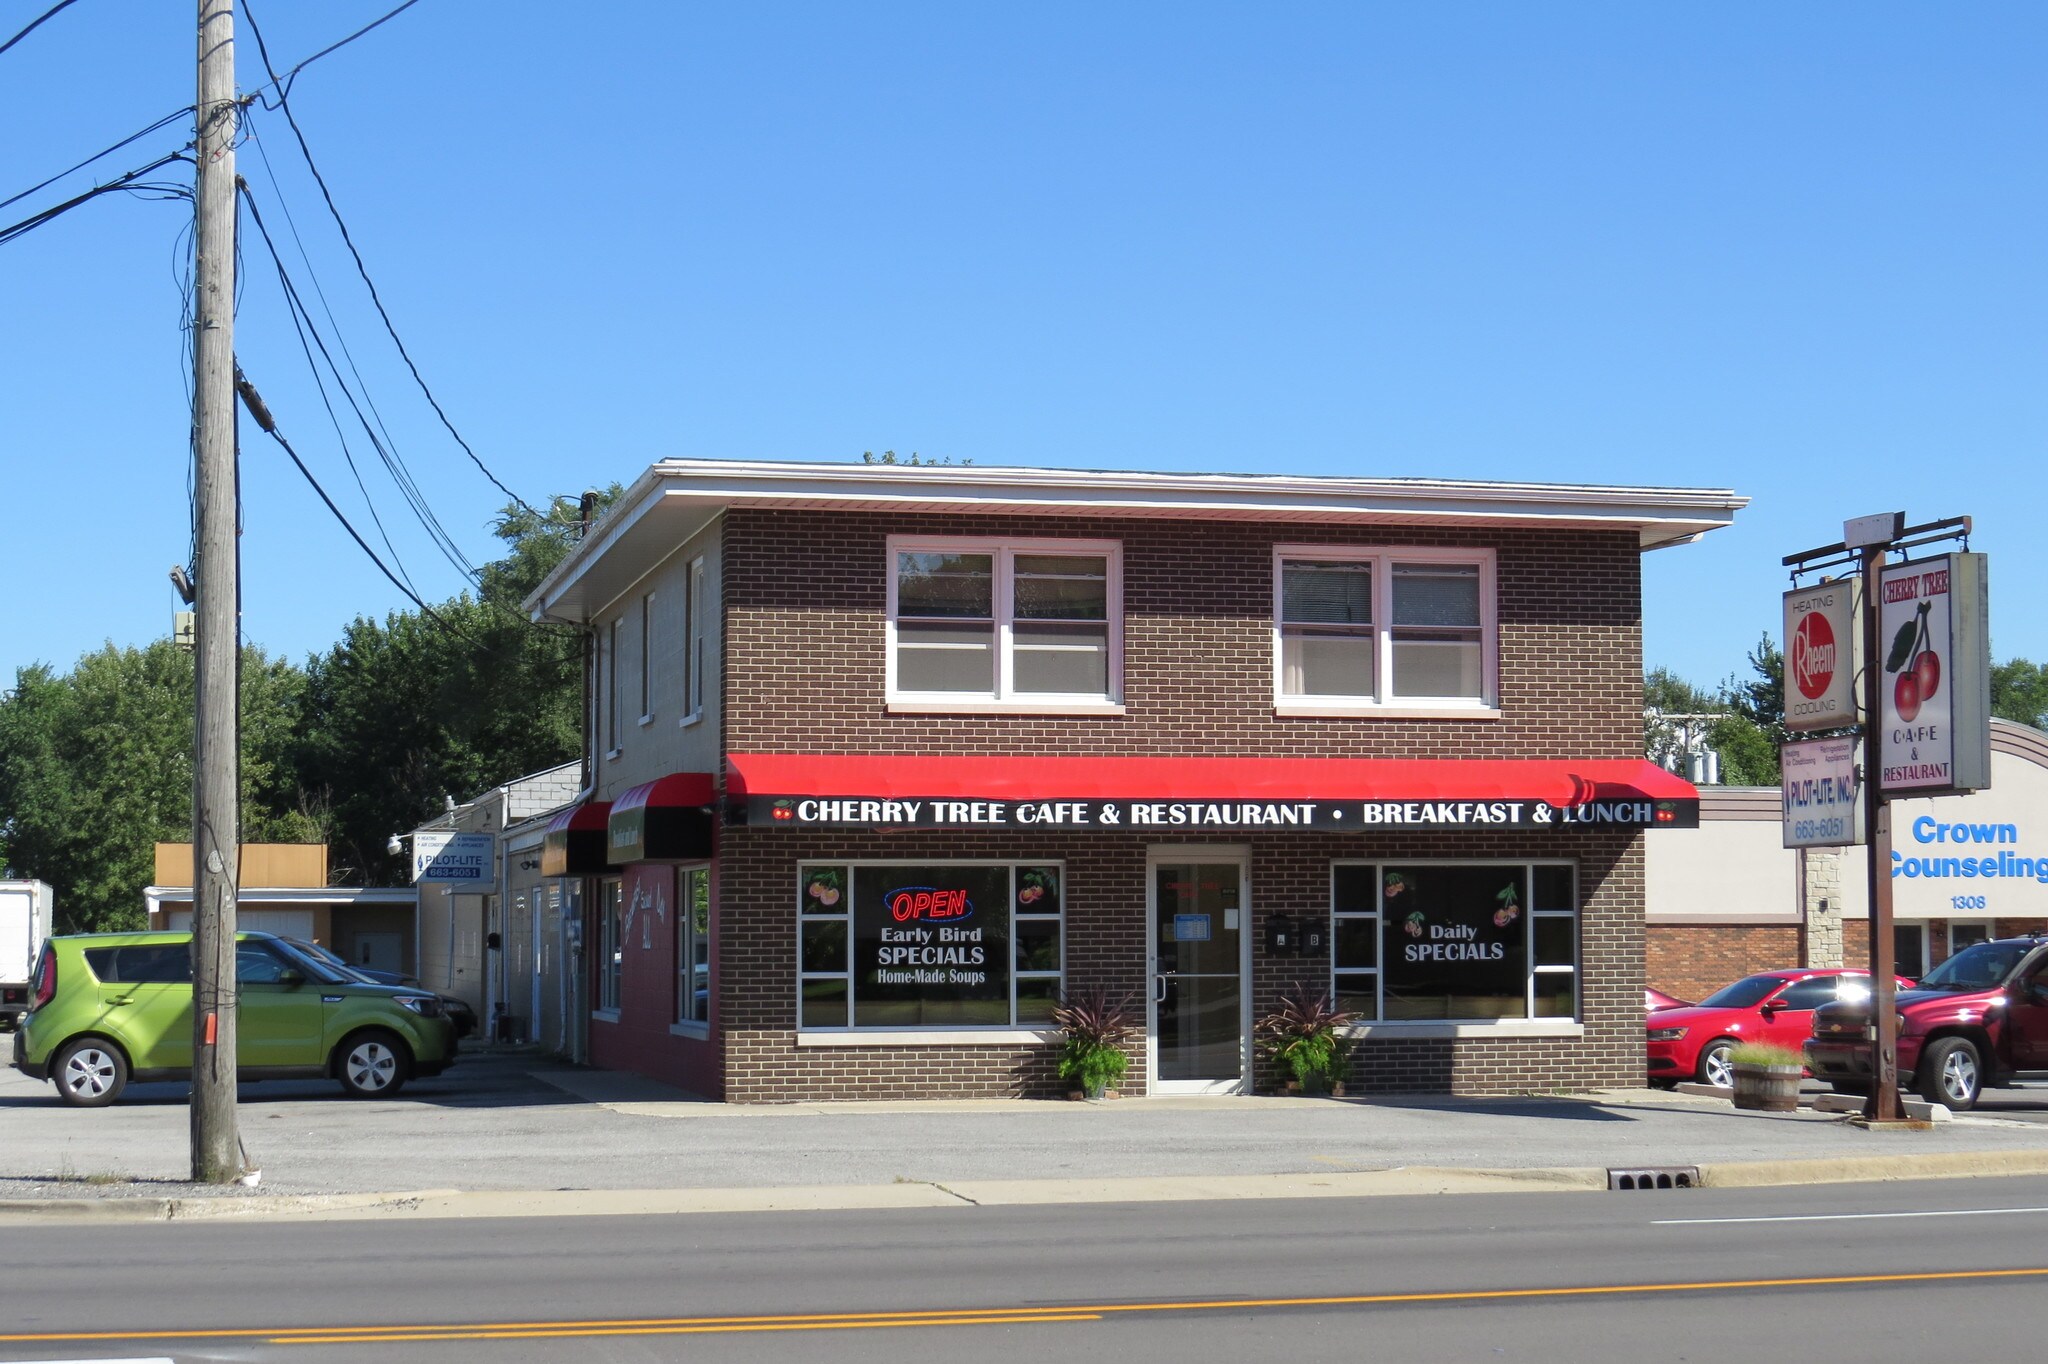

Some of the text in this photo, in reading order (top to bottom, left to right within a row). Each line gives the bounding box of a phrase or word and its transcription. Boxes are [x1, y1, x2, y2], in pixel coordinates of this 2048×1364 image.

[1883, 569, 1948, 605] CHERRY TREE
[1792, 595, 1834, 613] HEATING
[1796, 615, 1834, 688] Rheem
[1794, 699, 1836, 716] COOLING
[1911, 746, 1918, 761] &
[1884, 762, 1949, 782] RESTAURANT
[798, 800, 1652, 825] CHERRY TREE CAFE & RESTAURANT BREAKFAST & LUNCH
[1795, 818, 1844, 840] 663-6051
[1912, 815, 2018, 844] Crown
[425, 855, 483, 866] PILOT-LITE
[430, 868, 478, 877] 663-6051
[892, 889, 967, 922] OPEN
[1951, 895, 1987, 910] 1308
[881, 927, 983, 945] Early Bird
[1430, 924, 1478, 942] Daily
[878, 946, 985, 965] SPECIALS
[1405, 942, 1504, 962] SPECIALS
[877, 968, 986, 986] Home-Made Soups
